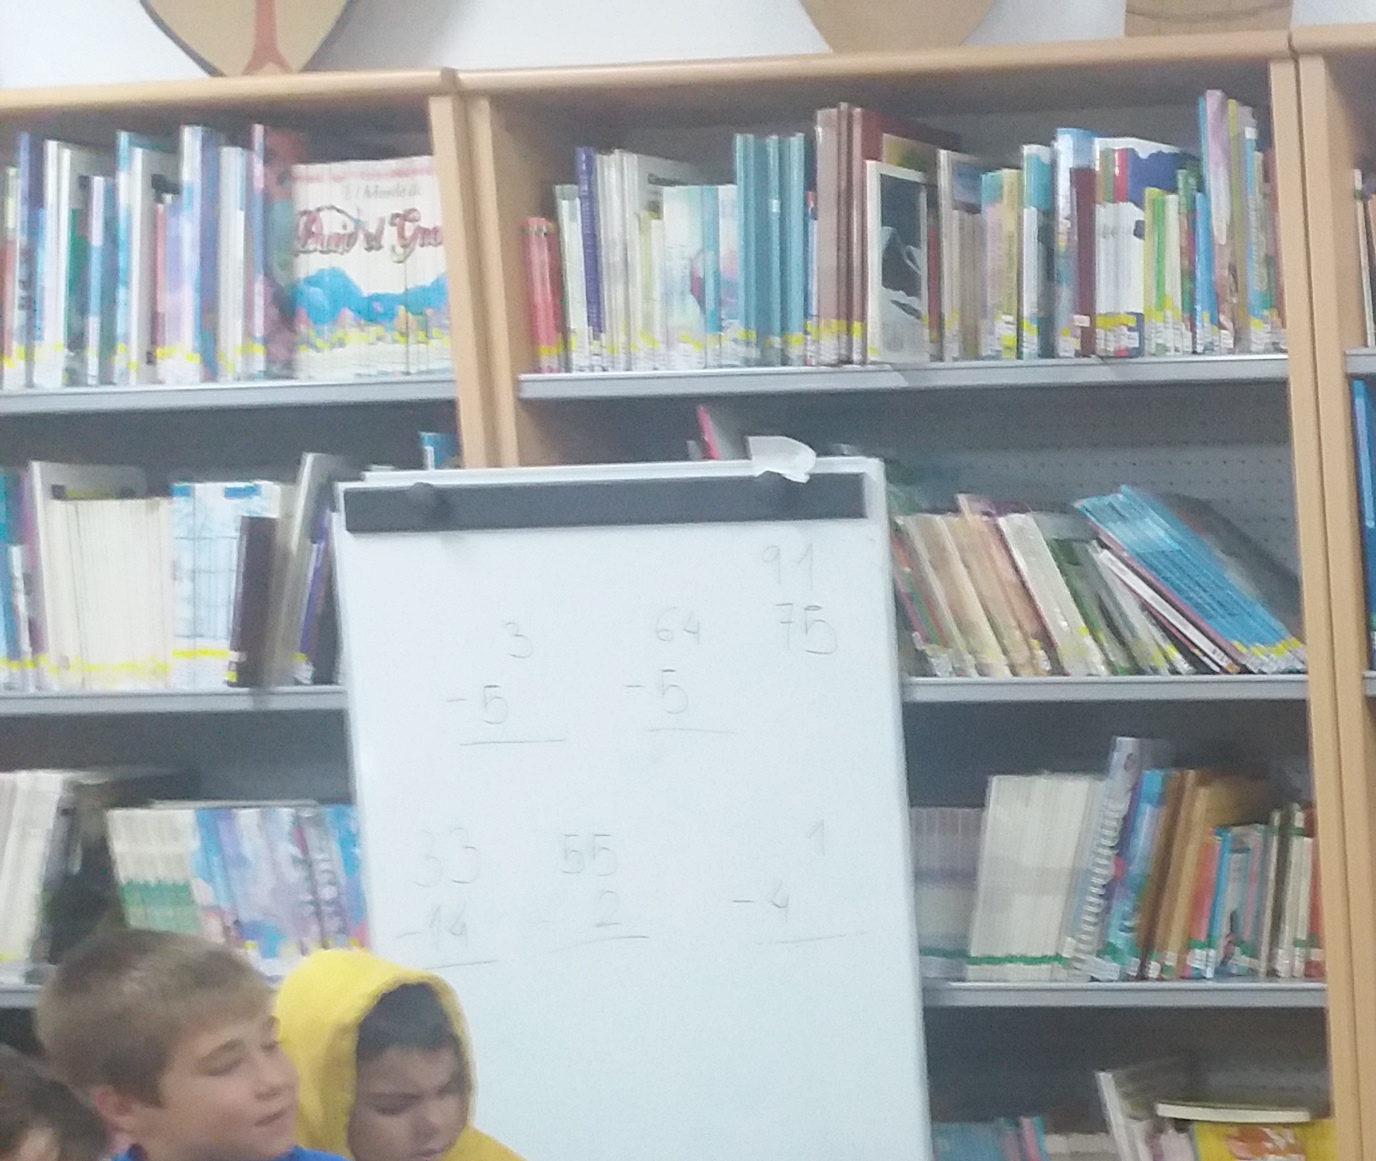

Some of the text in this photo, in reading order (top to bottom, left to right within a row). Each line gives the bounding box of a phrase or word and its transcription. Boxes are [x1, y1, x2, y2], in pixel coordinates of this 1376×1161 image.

[502, 620, 534, 660] 3
[654, 605, 702, 646] 64
[774, 601, 839, 656] 75
[559, 832, 619, 878] 55
